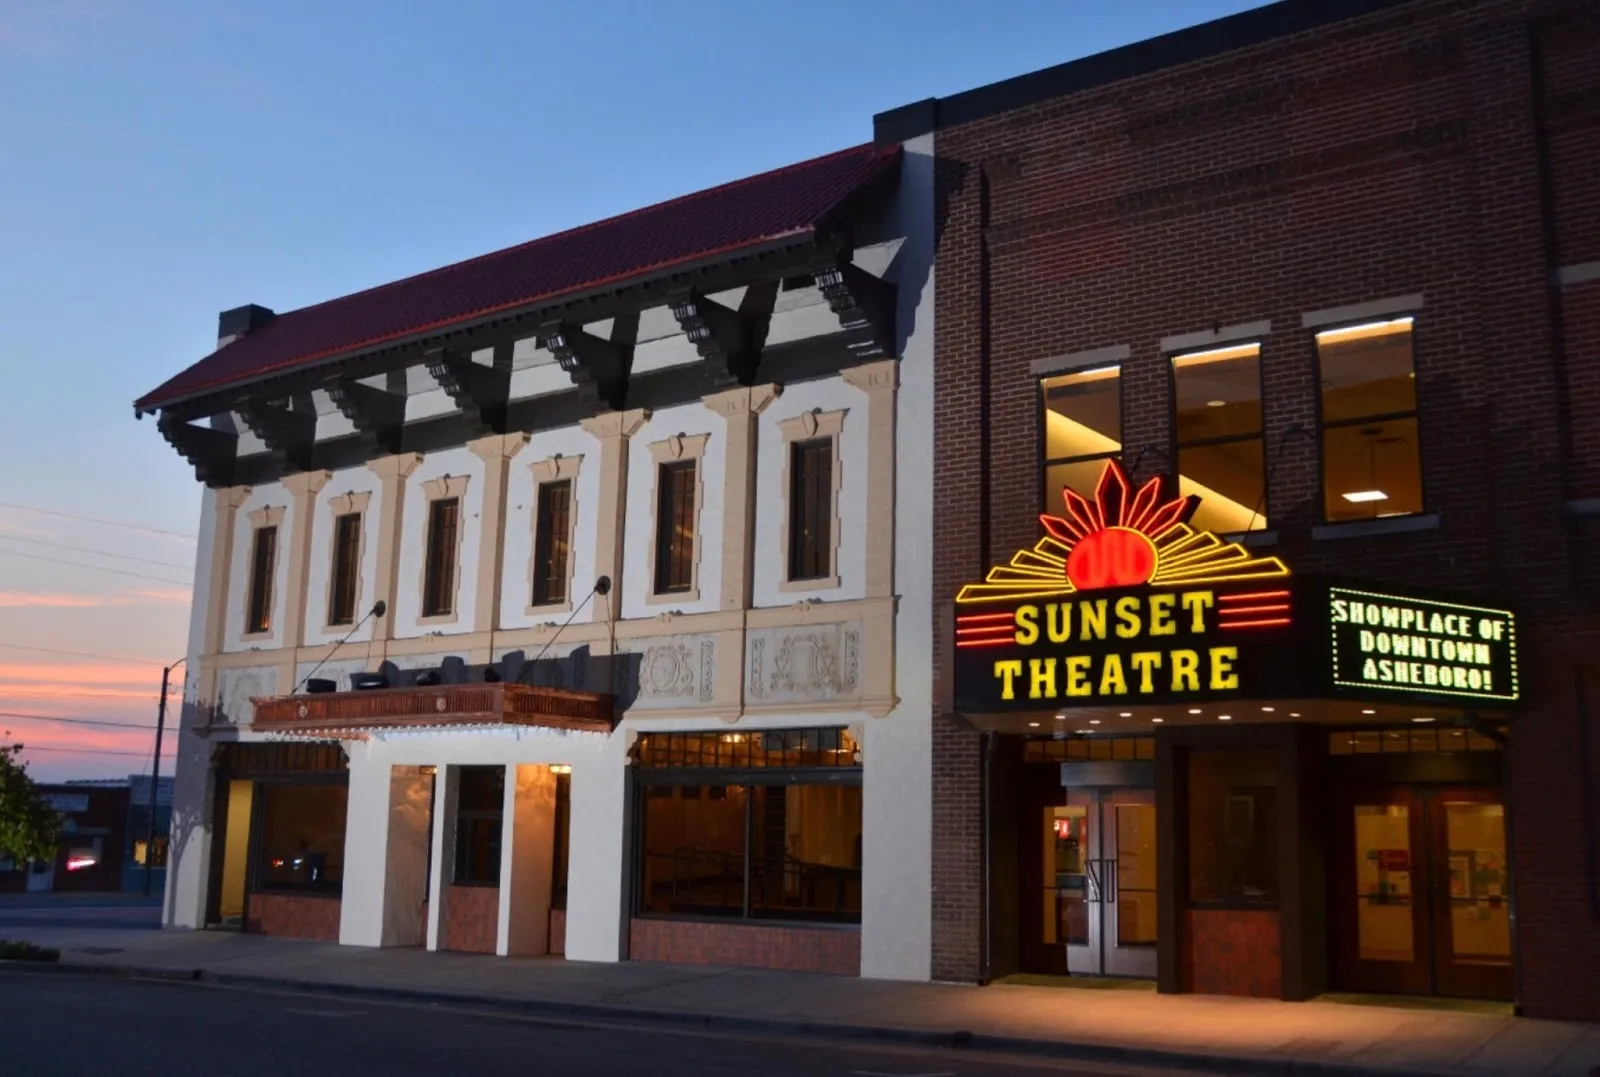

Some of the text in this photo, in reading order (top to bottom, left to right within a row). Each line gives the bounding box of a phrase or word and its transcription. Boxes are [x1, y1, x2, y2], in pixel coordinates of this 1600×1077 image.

[1014, 590, 1214, 646] SUNSET
[1333, 600, 1506, 641] SHOWPLACE OF
[1360, 630, 1491, 665] DOWNTOWN
[994, 646, 1239, 700] THEATRE
[1363, 658, 1493, 691] ASHEBORO!
